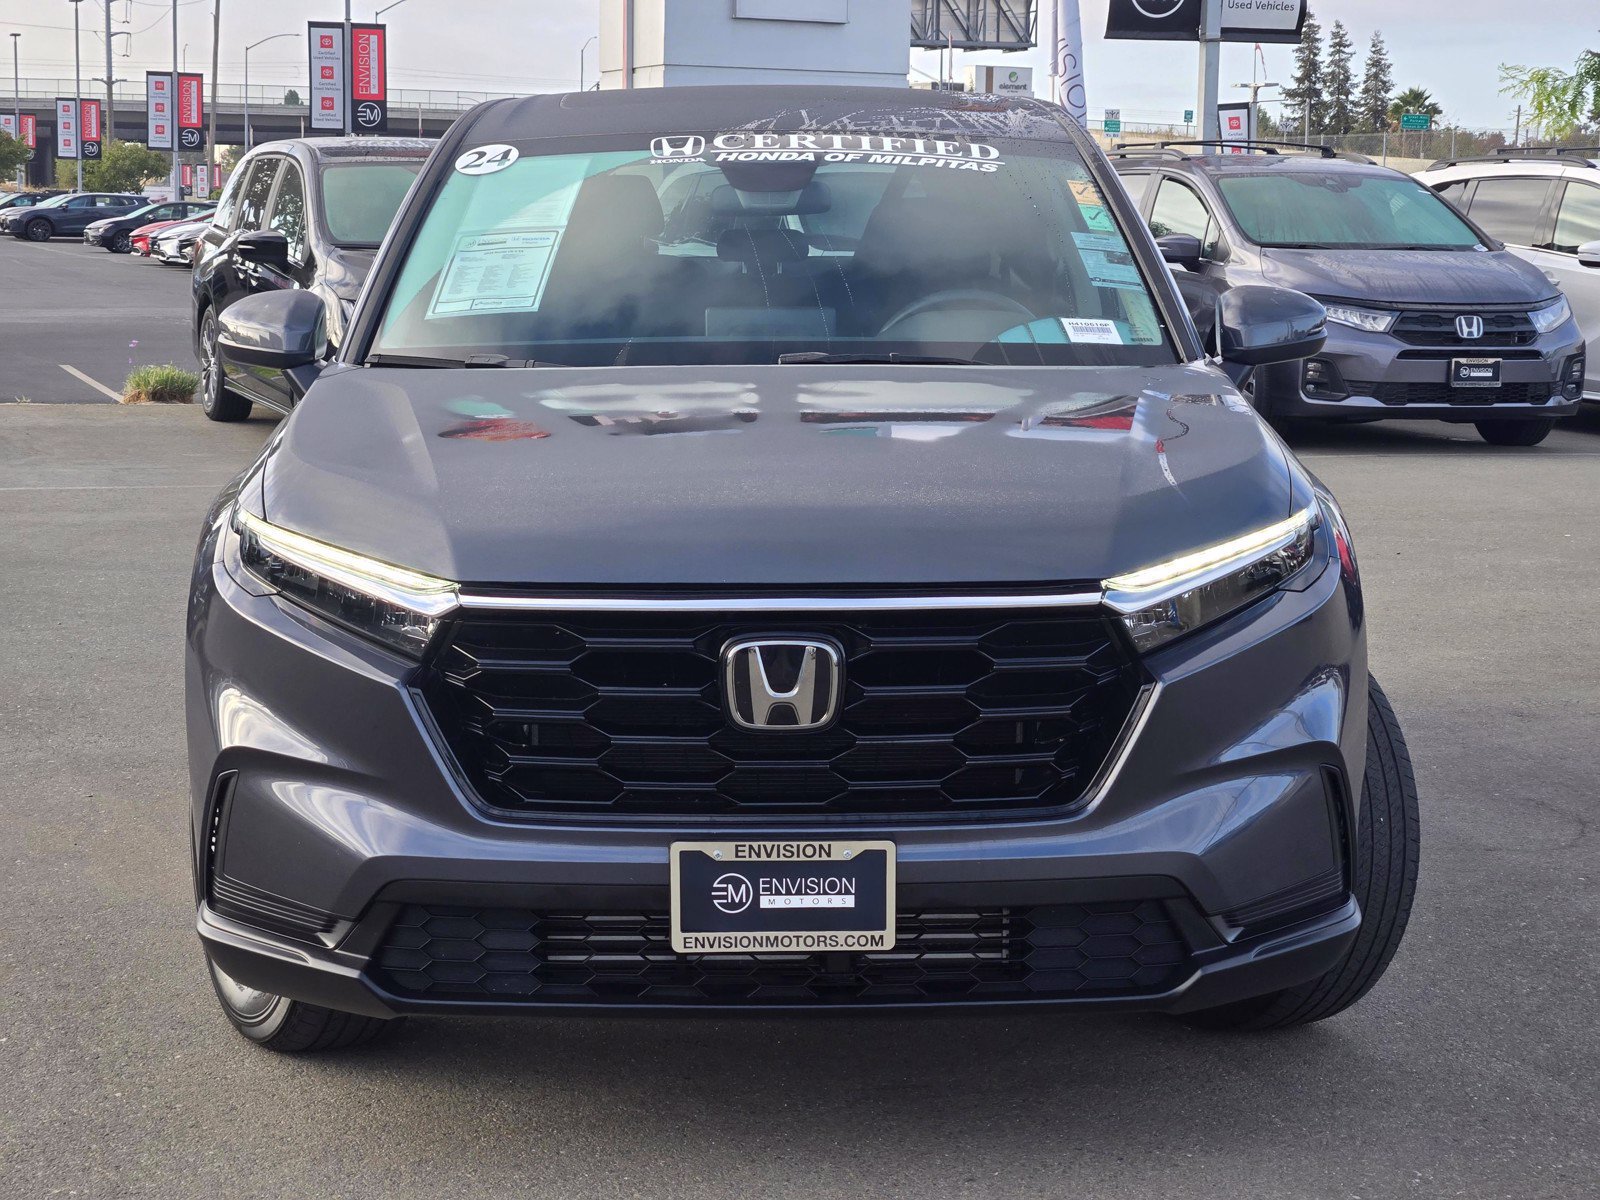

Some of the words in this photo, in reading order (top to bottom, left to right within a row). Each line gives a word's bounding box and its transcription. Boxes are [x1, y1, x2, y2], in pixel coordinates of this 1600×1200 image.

[1227, 0, 1253, 9] Used
[1255, 0, 1295, 11] Vehicles
[358, 34, 370, 94] ENVISION
[999, 83, 1027, 91] element
[182, 80, 191, 124] ENVISION
[713, 133, 1000, 160] CERTIFIED
[458, 148, 513, 170] 24
[650, 157, 707, 165] HONDA
[715, 152, 815, 162] HONDA
[823, 152, 864, 163] OF
[867, 154, 999, 173] MILPITAS
[734, 844, 832, 859] ENVISION
[759, 877, 856, 895] ENVISION
[767, 897, 847, 906] MOTORS
[682, 935, 884, 949] ENVISIONMOTORS.COM
